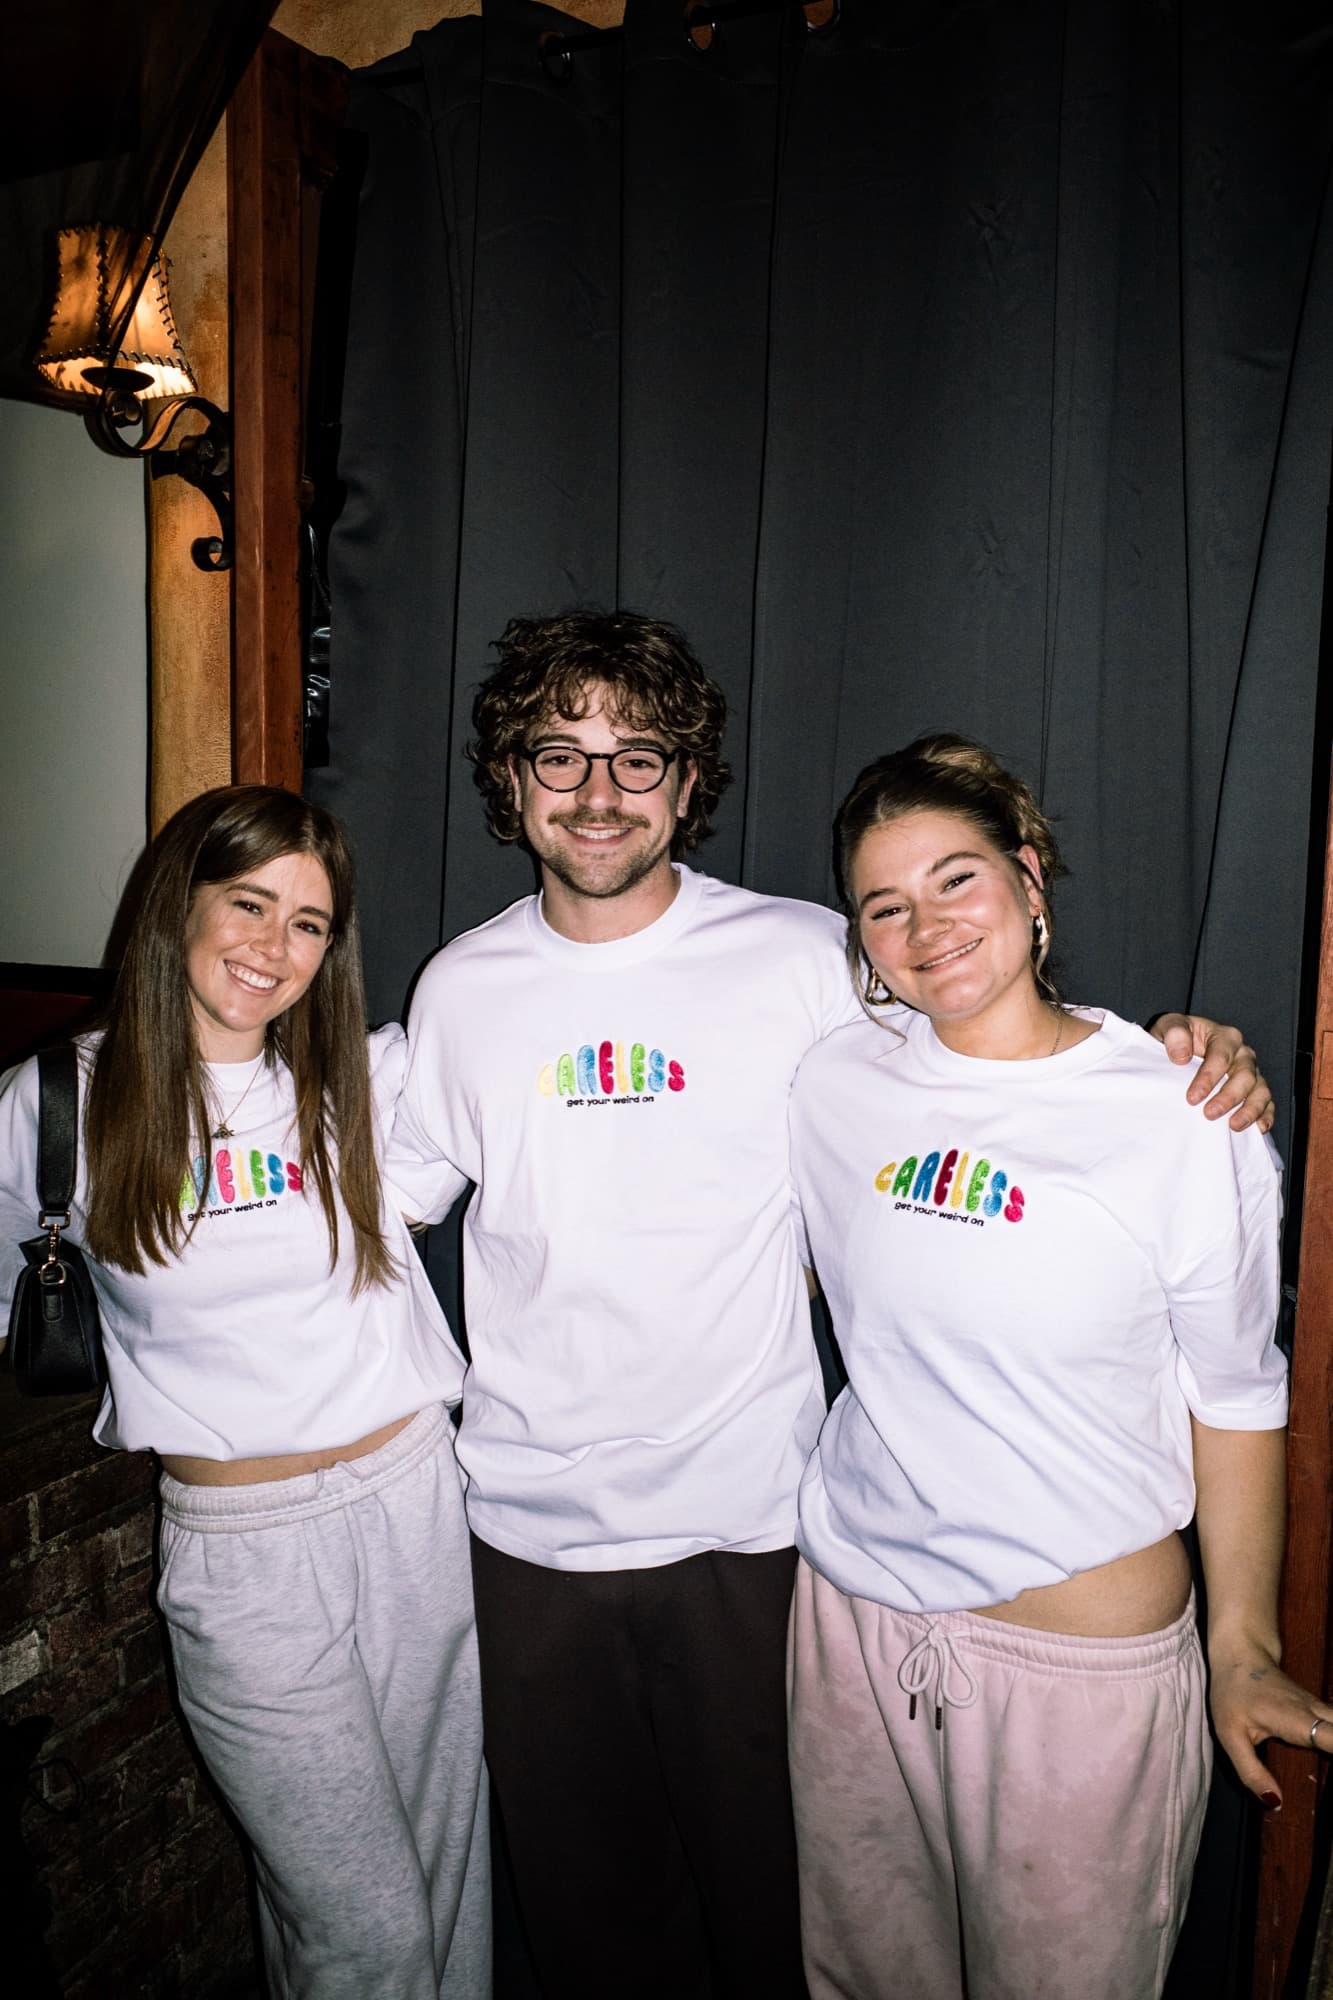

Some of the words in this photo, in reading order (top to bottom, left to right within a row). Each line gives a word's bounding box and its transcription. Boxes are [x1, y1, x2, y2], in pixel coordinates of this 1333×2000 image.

[537, 1040, 685, 1096] CARELESS
[567, 1099, 584, 1107] get
[587, 1098, 610, 1107] your
[613, 1096, 640, 1105] weird
[177, 1149, 301, 1210] ARELESS
[875, 1149, 1025, 1223] CARELESS
[208, 1207, 232, 1218] your
[235, 1201, 263, 1212] weird
[894, 1201, 912, 1211] get
[914, 1205, 937, 1217] your
[939, 1211, 968, 1223] weird
[971, 1218, 985, 1227] on
